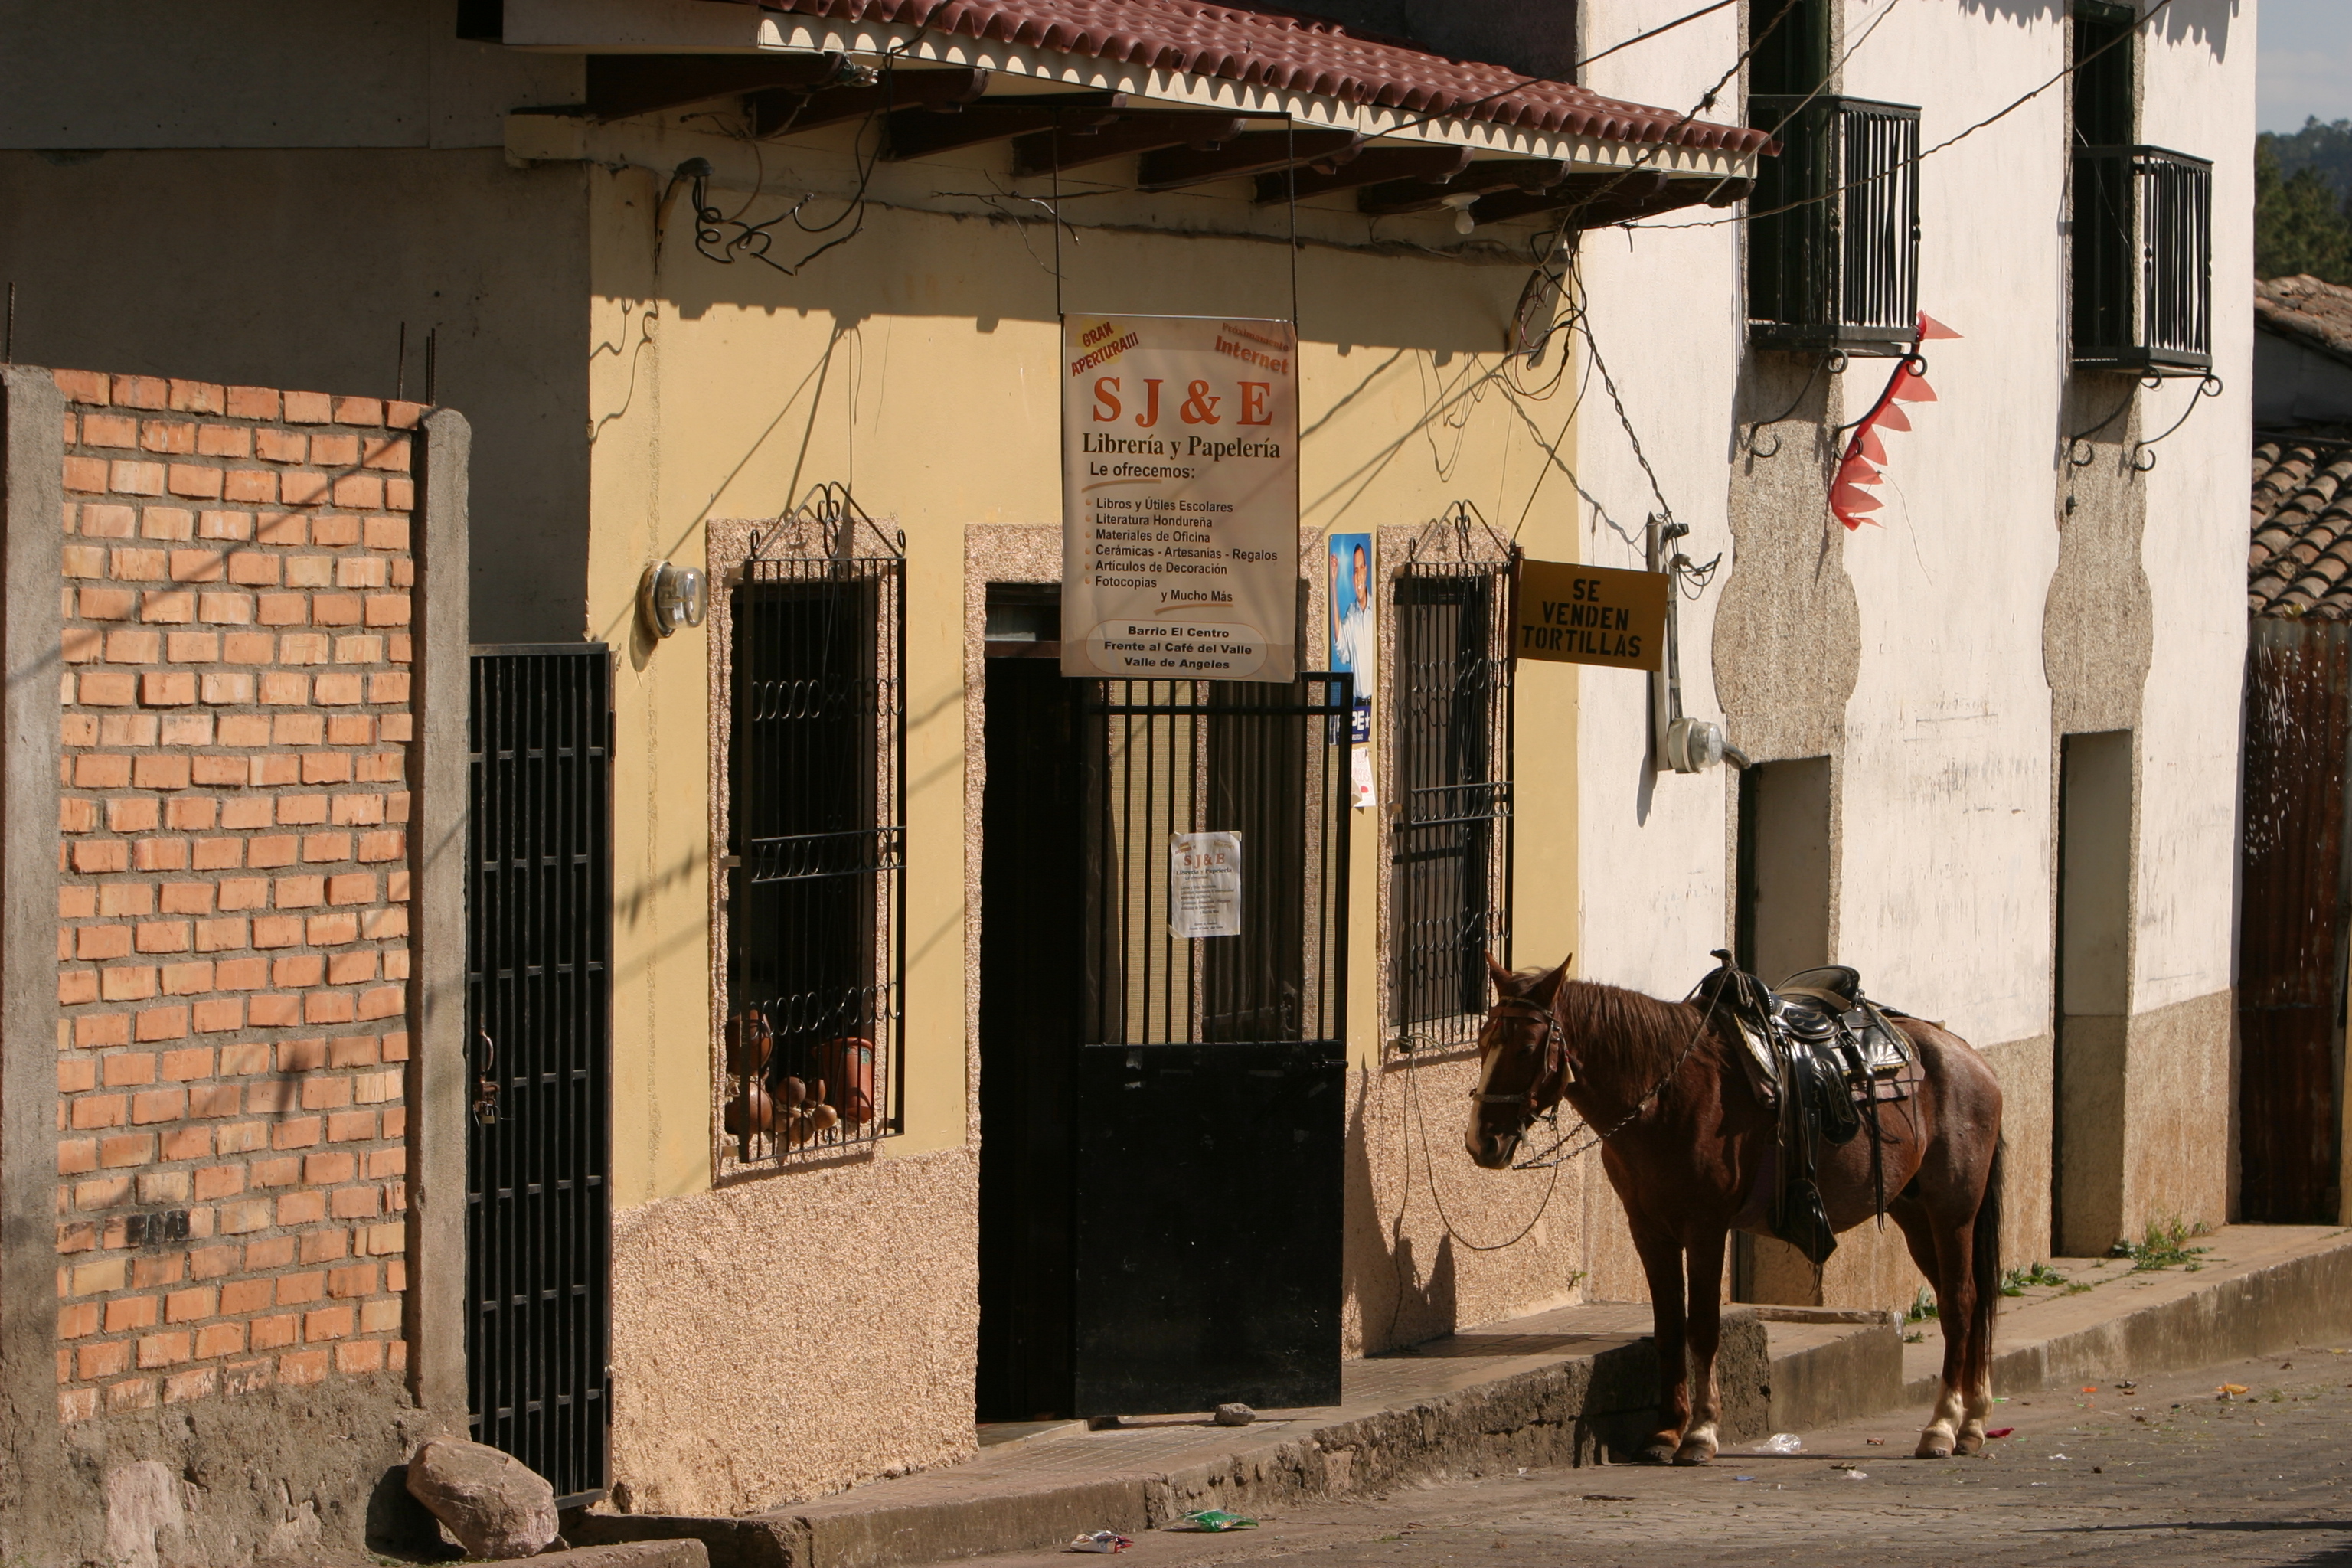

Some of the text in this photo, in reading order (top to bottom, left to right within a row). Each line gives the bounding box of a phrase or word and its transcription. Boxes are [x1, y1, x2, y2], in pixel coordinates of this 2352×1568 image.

[1083, 322, 1114, 347] GRAN
[1223, 322, 1289, 351] Próximamente
[1215, 335, 1289, 374] Internet
[1093, 377, 1273, 427] S J & E
[1083, 433, 1280, 462] Librería y Papelería
[1091, 462, 1195, 479] Le ofrecemos:
[1096, 497, 1233, 512] Libros y Útiles Escolares
[1096, 514, 1213, 527] Literatura Hondureña
[1096, 530, 1210, 542] Materiales de Oficina
[1096, 545, 1155, 557] Cerámicas
[1233, 549, 1277, 562] Regalos
[1096, 560, 1227, 574] Artículos de Decoración
[1096, 577, 1157, 590] Fotocopias
[1573, 579, 1600, 602] SE
[1161, 590, 1233, 603] y Mucho Más
[1542, 601, 1628, 631] VENDEN
[1128, 626, 1229, 638] Barrio El Centro
[1104, 642, 1252, 655] Frente al Café del Valle
[1522, 626, 1642, 658] TORTILLAS
[1125, 658, 1230, 670] Valle de Angeles
